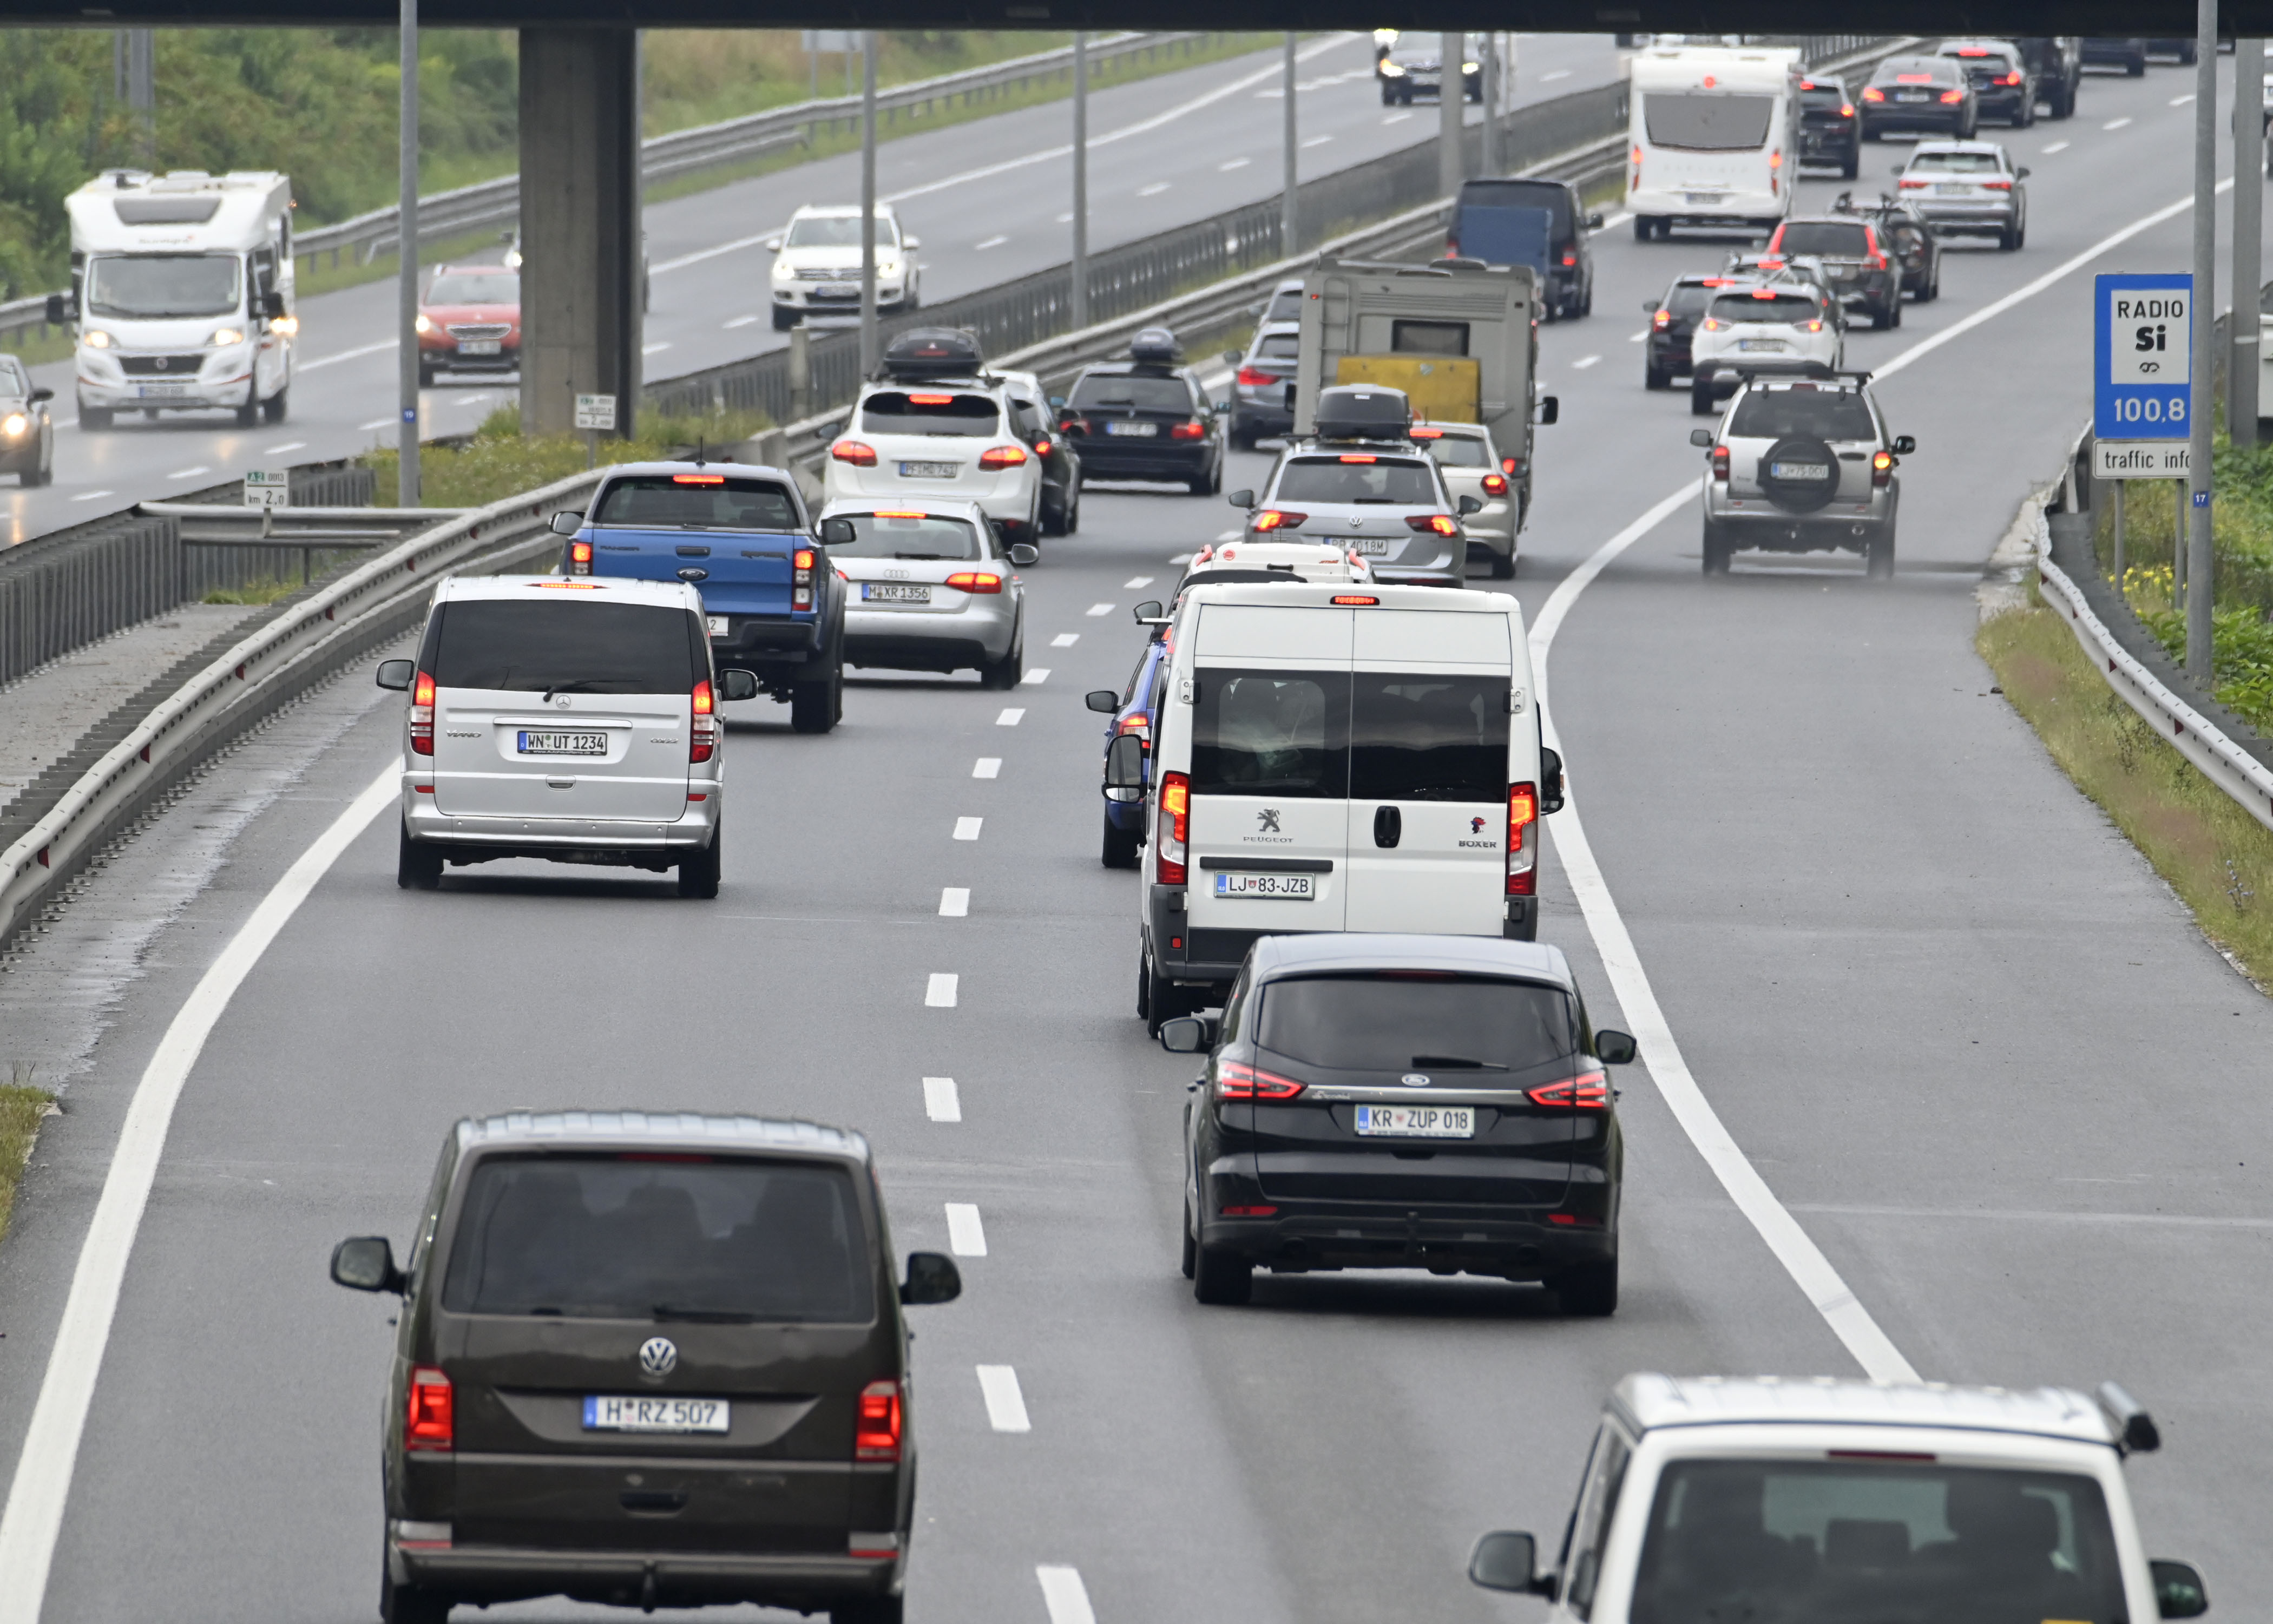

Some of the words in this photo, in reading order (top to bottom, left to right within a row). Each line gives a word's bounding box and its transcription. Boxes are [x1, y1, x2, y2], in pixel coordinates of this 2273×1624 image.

[2117, 300, 2184, 318] RADIO
[2135, 324, 2166, 352] Si
[2114, 397, 2185, 423] 100,8
[2105, 450, 2154, 469] traffic
[250, 473, 262, 481] A2
[249, 494, 260, 504] km
[869, 586, 876, 597] M
[884, 587, 898, 598] XR
[900, 587, 928, 599] 1356
[528, 734, 544, 748] WN
[554, 735, 570, 749] UT
[573, 736, 604, 749] 1234
[1459, 839, 1497, 848] BOXER
[1230, 877, 1247, 892] LJ
[1258, 877, 1309, 893] 83-JZB
[1372, 1109, 1392, 1127] KR
[1407, 1110, 1437, 1128] ZUP
[1443, 1110, 1468, 1129] 018
[607, 1400, 621, 1422] H
[638, 1401, 668, 1423] RZ
[674, 1402, 717, 1424] 507
